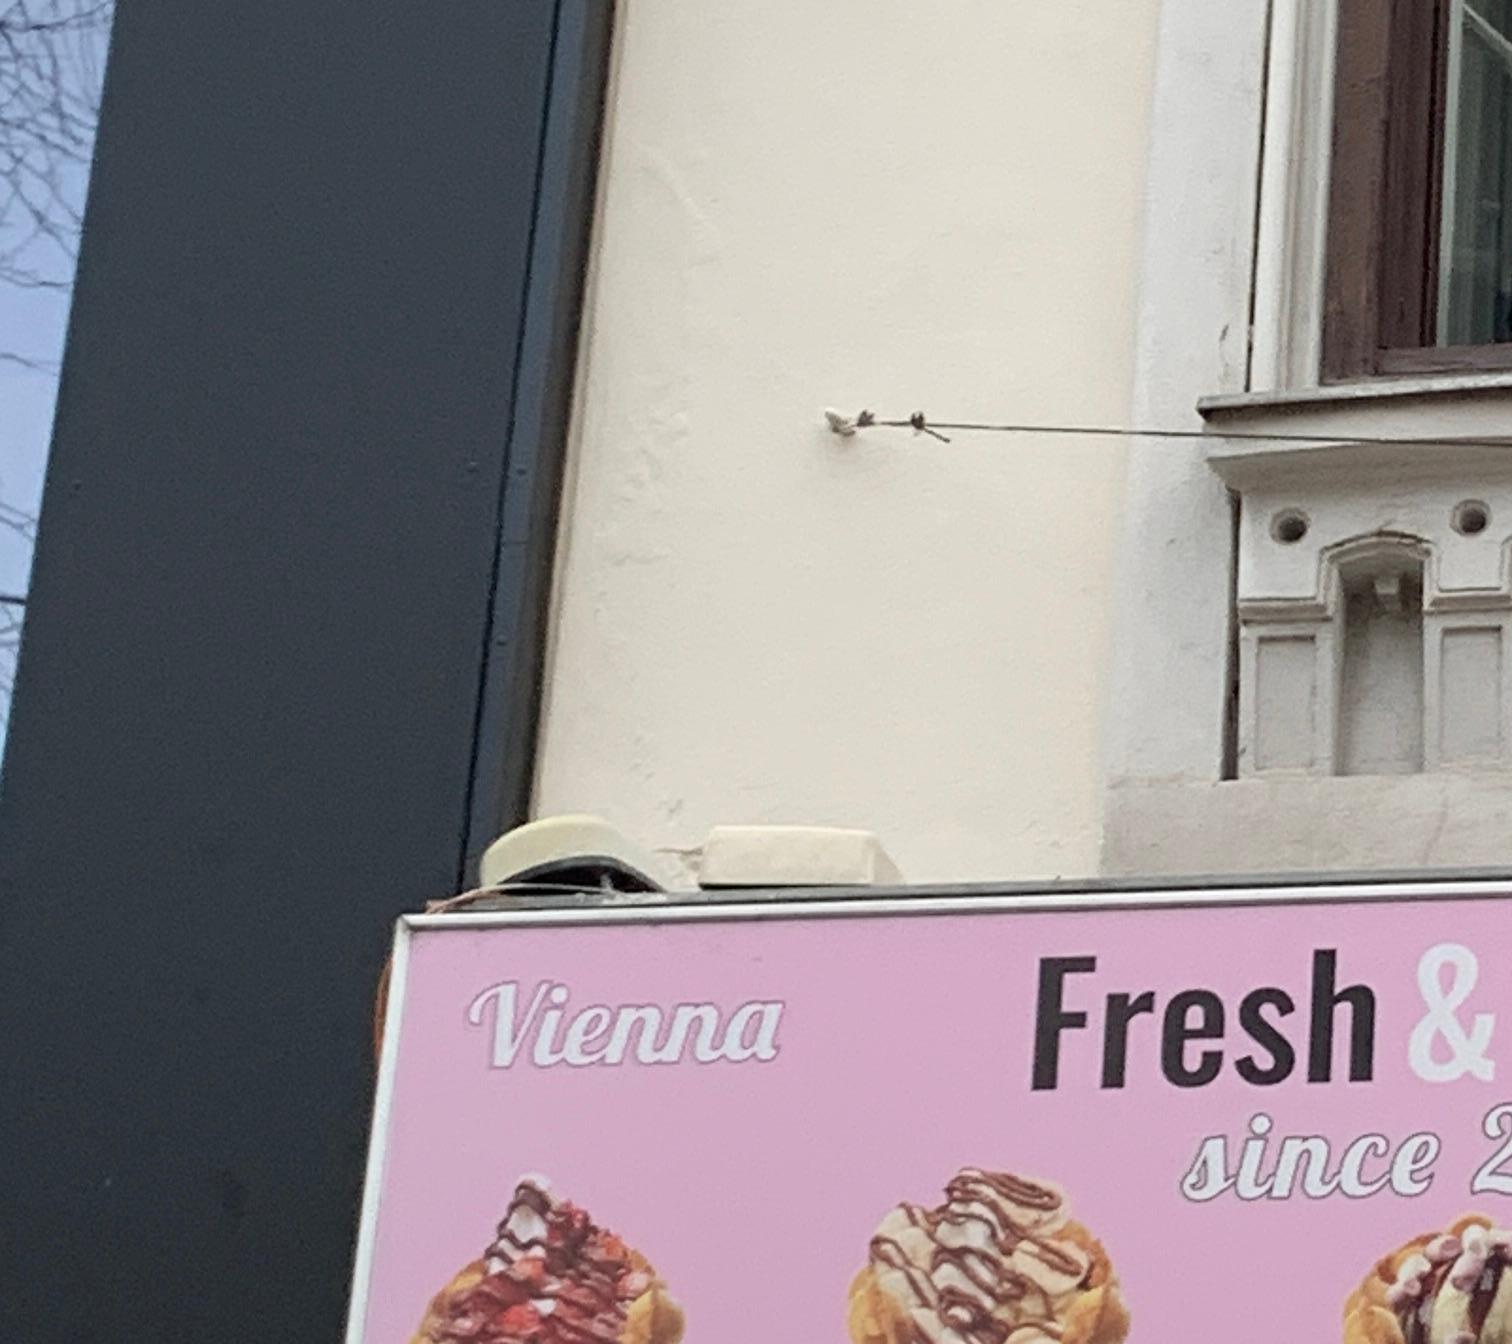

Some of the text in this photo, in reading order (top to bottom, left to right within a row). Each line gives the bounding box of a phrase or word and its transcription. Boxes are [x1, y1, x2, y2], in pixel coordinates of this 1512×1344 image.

[466, 979, 786, 1069] Vienna
[1031, 948, 1376, 1091] Fresh
[1408, 943, 1495, 1083] &
[1179, 1112, 1441, 1202] since
